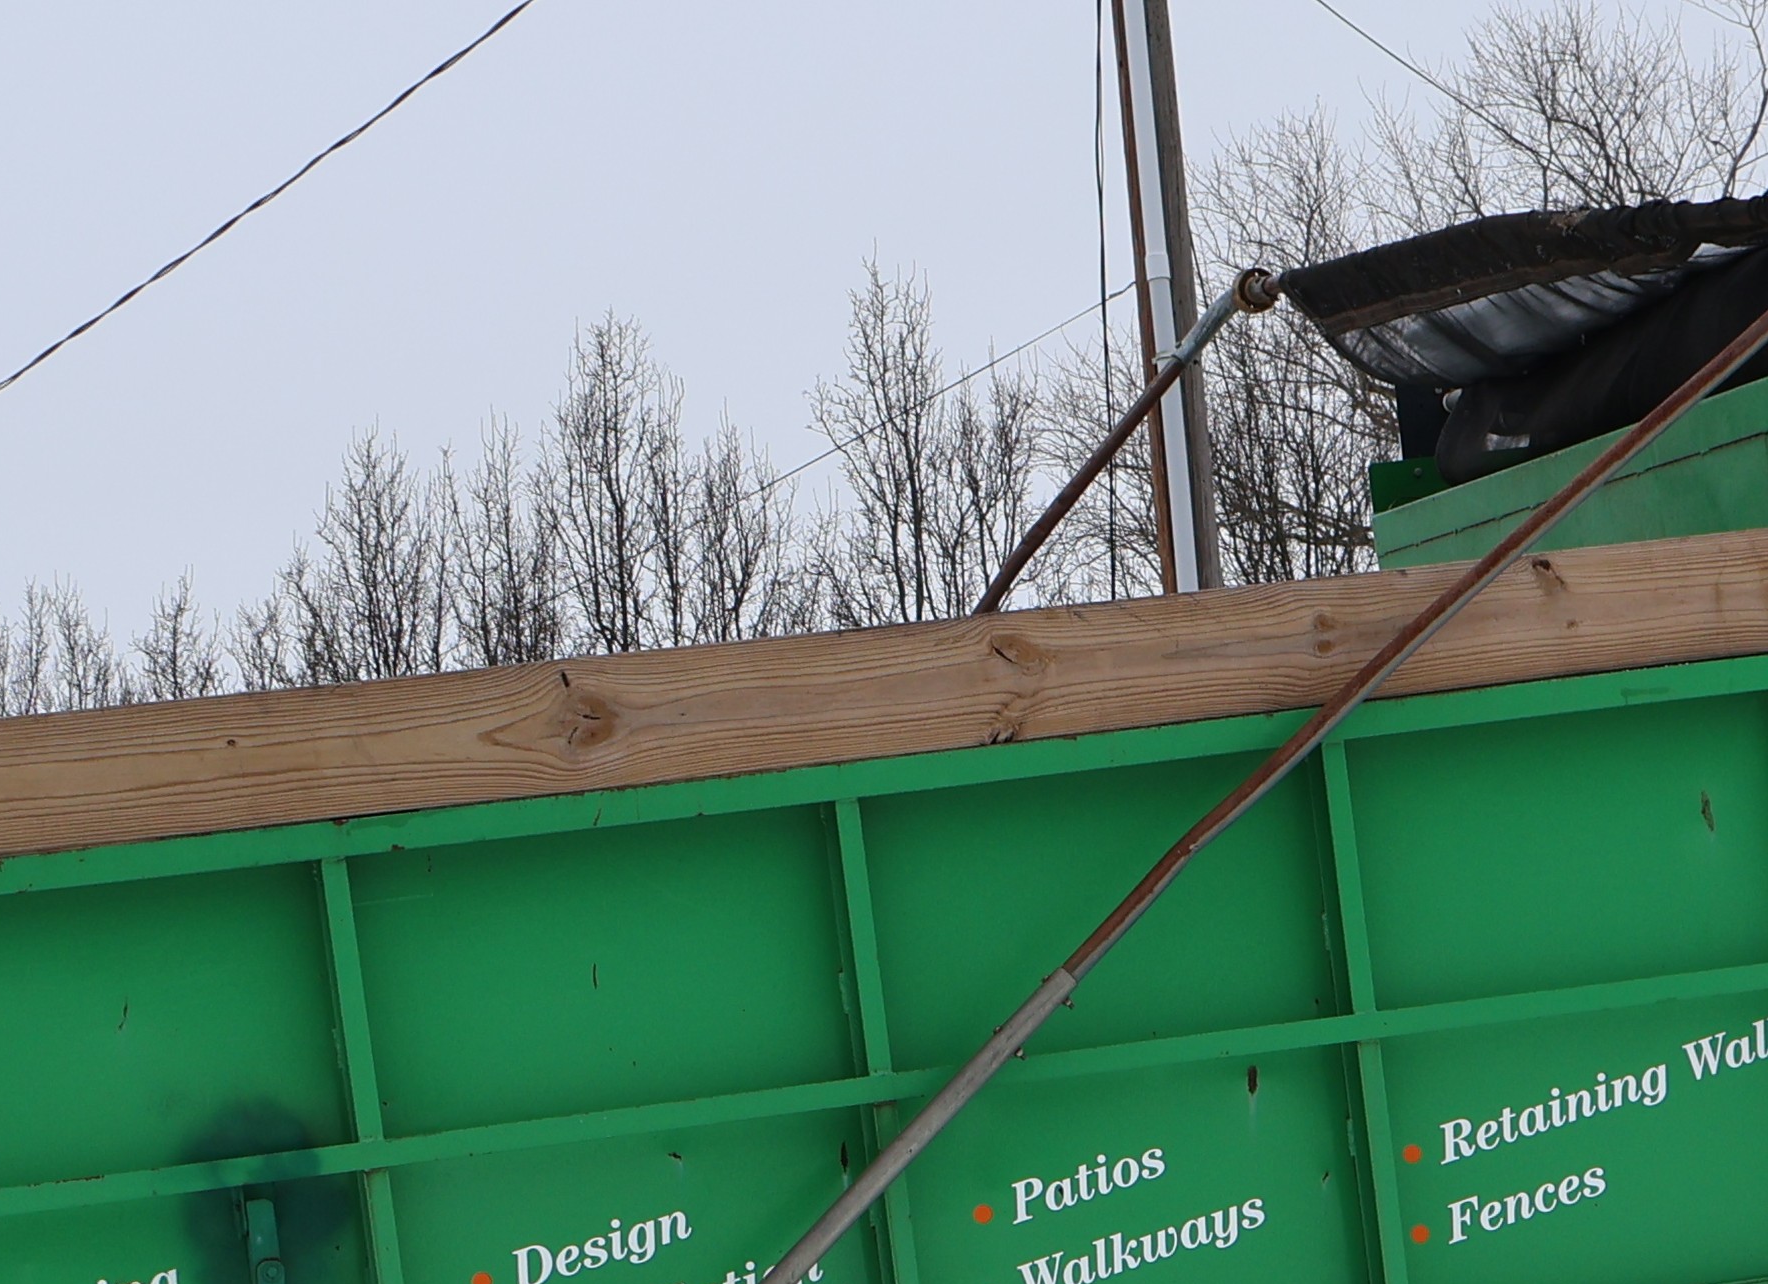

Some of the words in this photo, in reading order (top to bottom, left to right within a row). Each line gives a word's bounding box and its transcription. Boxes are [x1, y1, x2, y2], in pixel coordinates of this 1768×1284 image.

[1438, 1062, 1669, 1166] Retaining
[1010, 1146, 1166, 1225] Patios
[1446, 1165, 1607, 1246] Fences
